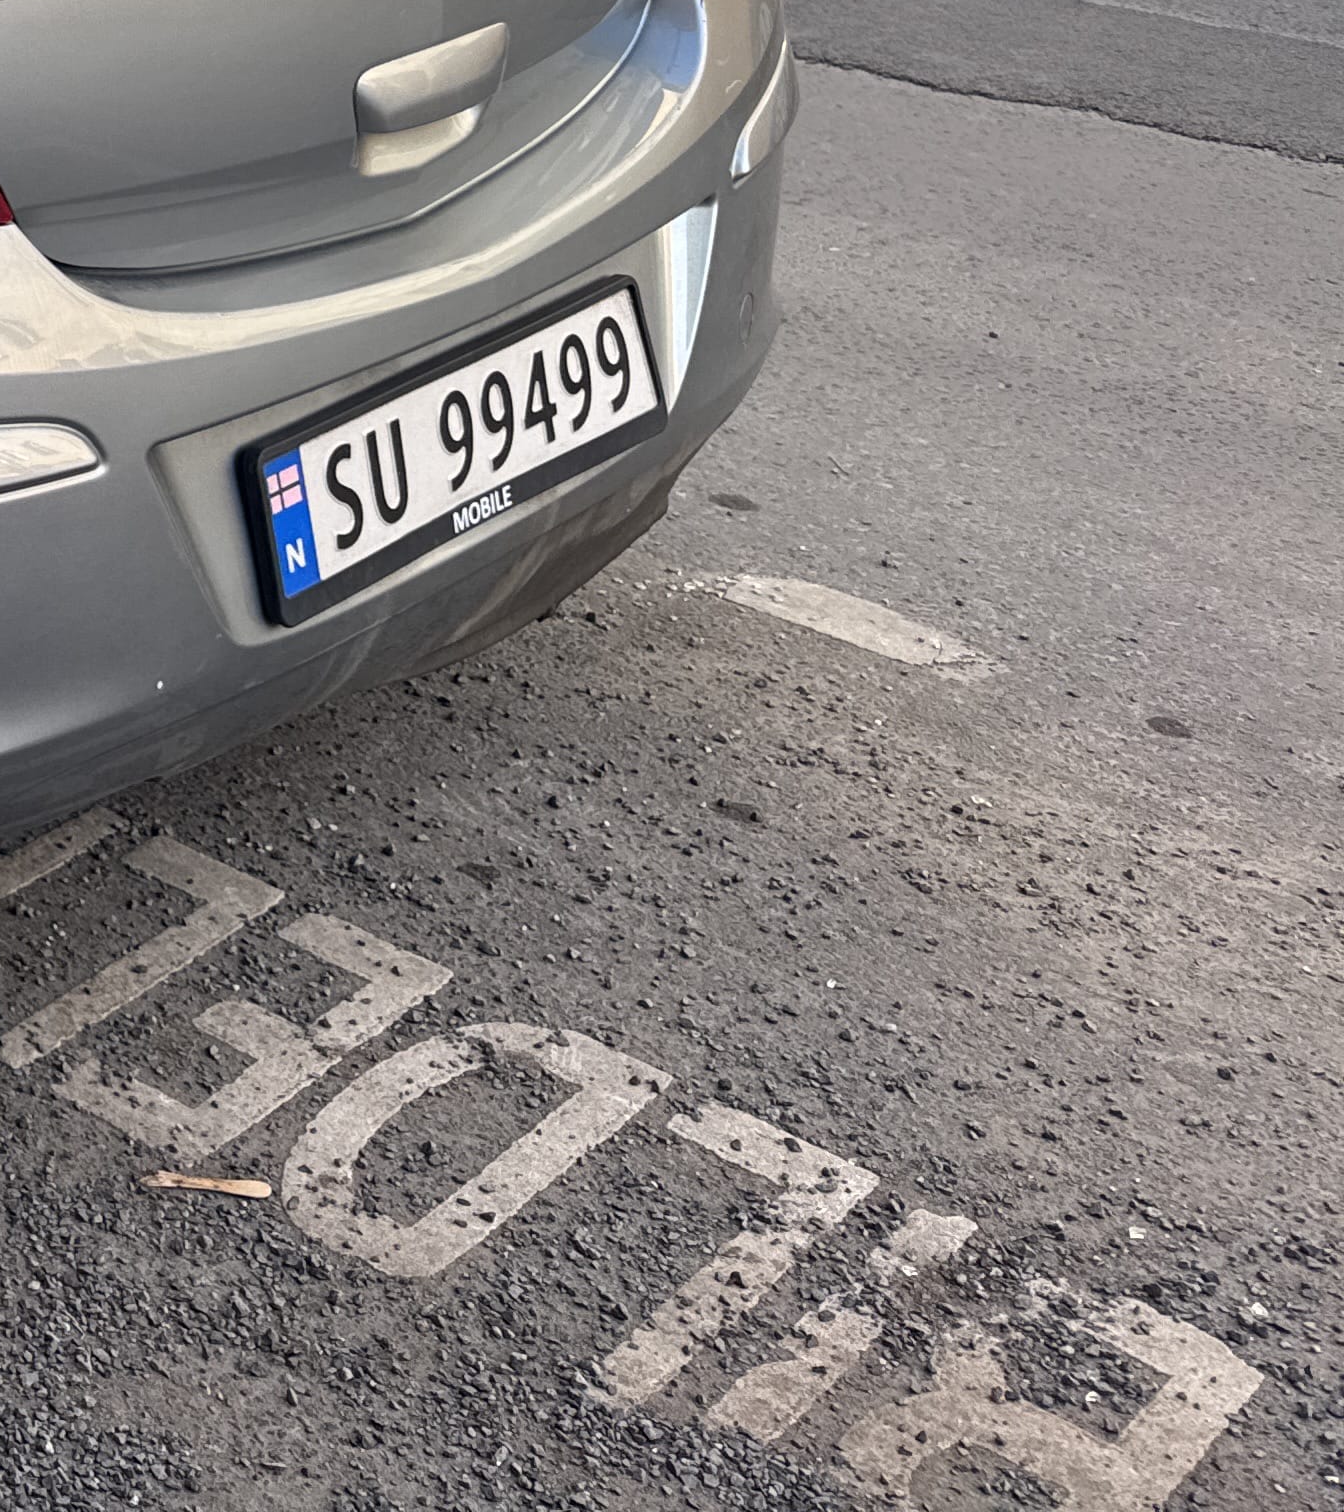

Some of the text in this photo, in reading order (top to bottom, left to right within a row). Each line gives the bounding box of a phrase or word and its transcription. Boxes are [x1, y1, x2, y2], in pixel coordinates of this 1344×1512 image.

[325, 315, 631, 550] SU 99499
[451, 485, 513, 534] MOBILE
[285, 538, 306, 574] N
